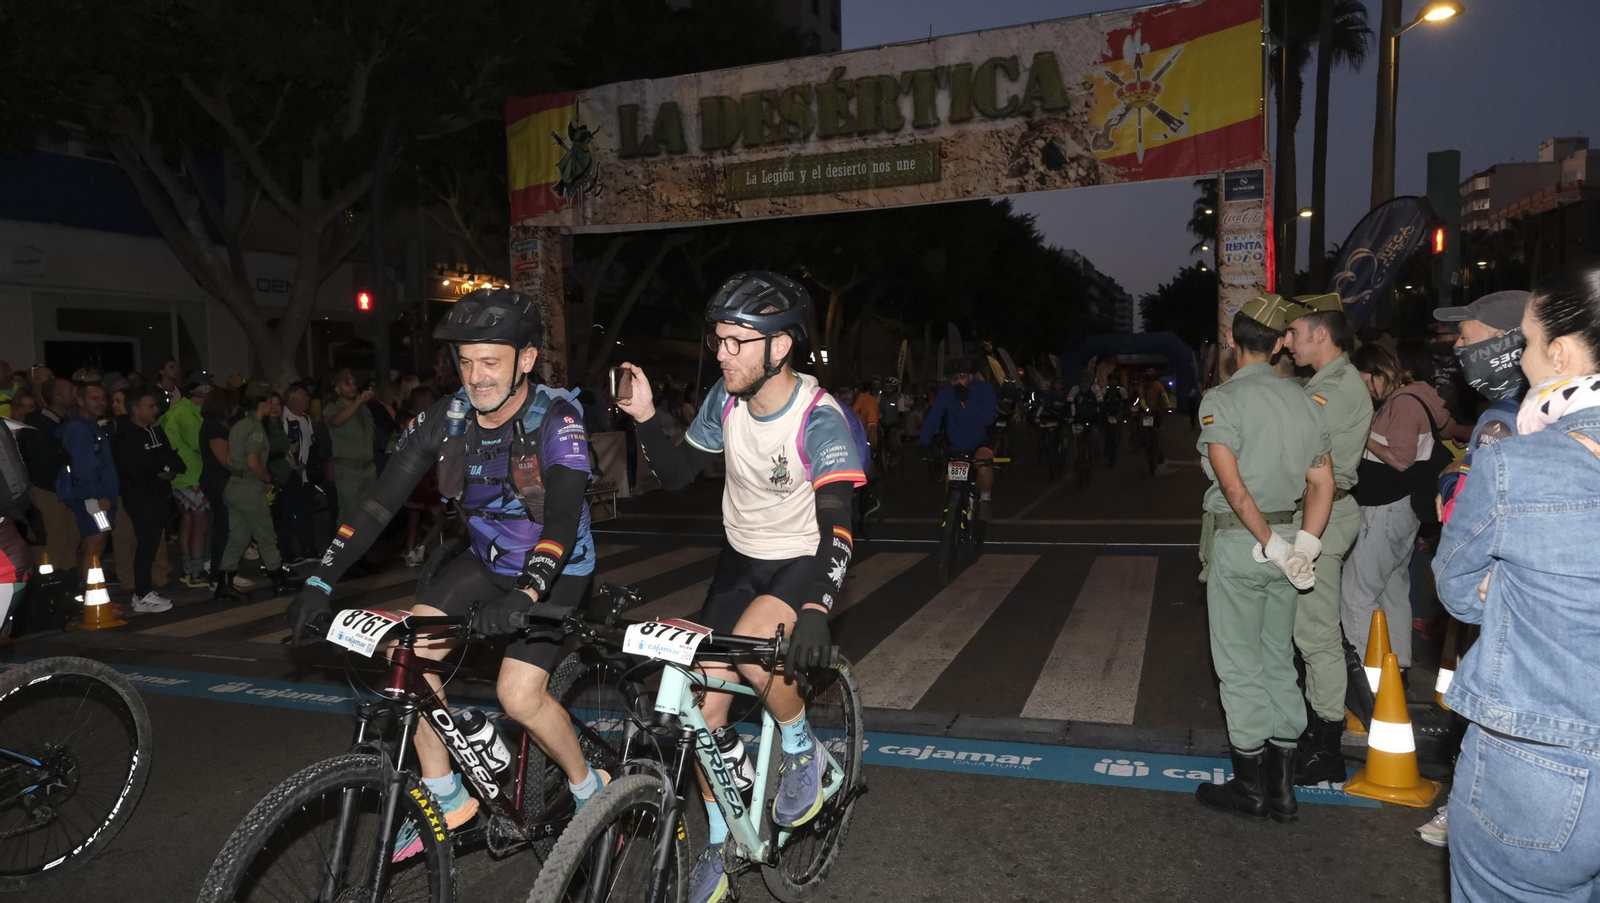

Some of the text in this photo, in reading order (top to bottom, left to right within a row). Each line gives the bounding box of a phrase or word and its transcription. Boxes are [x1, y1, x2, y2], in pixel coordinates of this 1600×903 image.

[617, 51, 1070, 159] LA DESÉRTICA
[746, 159, 916, 186] La Legión y el desierto nos une
[1225, 241, 1263, 252] RENTA
[343, 610, 393, 637] 8767
[640, 622, 698, 645] 8771
[344, 635, 366, 648] cajamar
[647, 643, 680, 655] cajamar
[246, 687, 354, 704] cajamar
[431, 708, 500, 799] ORBEA
[878, 745, 1043, 766] cajamar
[696, 727, 744, 820] ORBEA
[991, 763, 1034, 771] RURAL
[410, 788, 446, 842] MAXXIS
